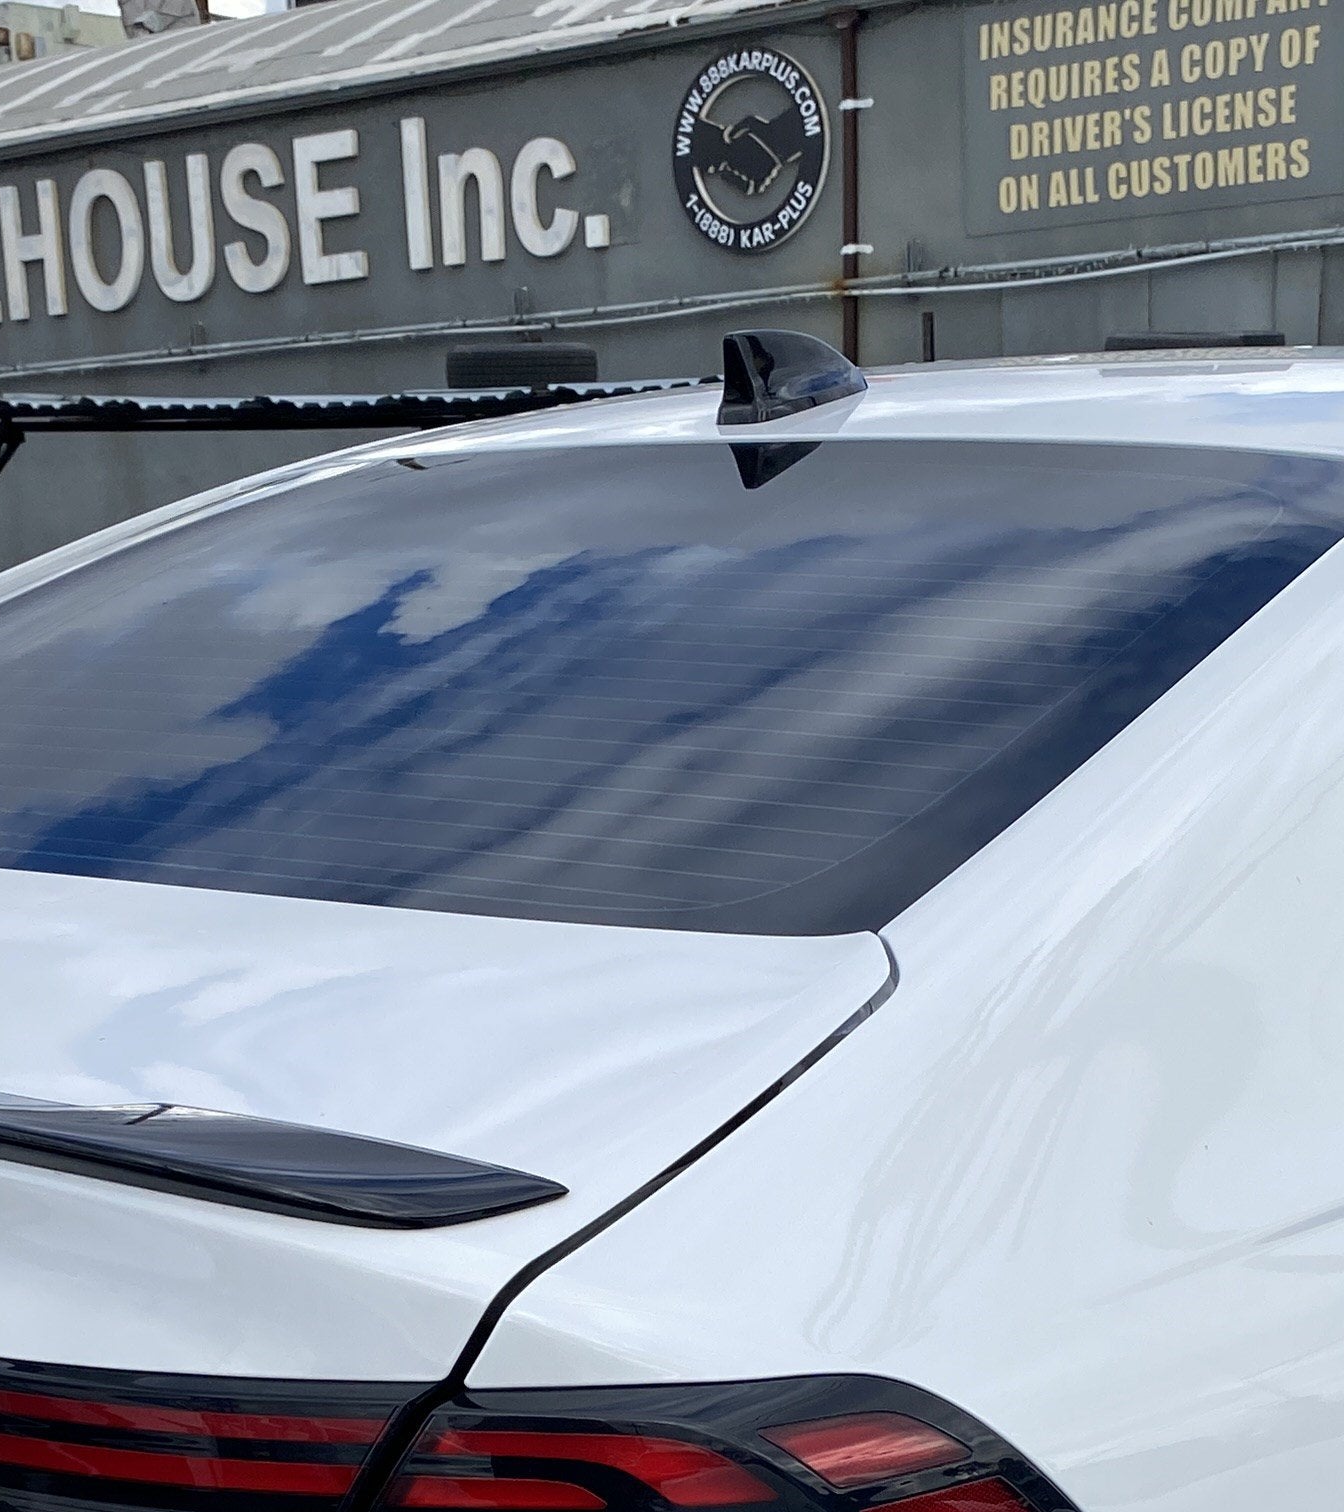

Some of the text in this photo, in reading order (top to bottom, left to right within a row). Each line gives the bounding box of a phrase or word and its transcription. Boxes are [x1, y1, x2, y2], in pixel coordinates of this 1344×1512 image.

[979, 0, 1157, 61] INSURANCE
[990, 25, 1321, 110] REQUIRES A COPY OF
[676, 51, 821, 157] WWW.888KARPLUS.COM
[1010, 85, 1297, 160] DRIVER'S LICENSE
[400, 117, 610, 270] Inc.
[999, 138, 1310, 213] ON ALL CUSTOMERS
[685, 181, 813, 248] 1-(888) KAR-PLUS
